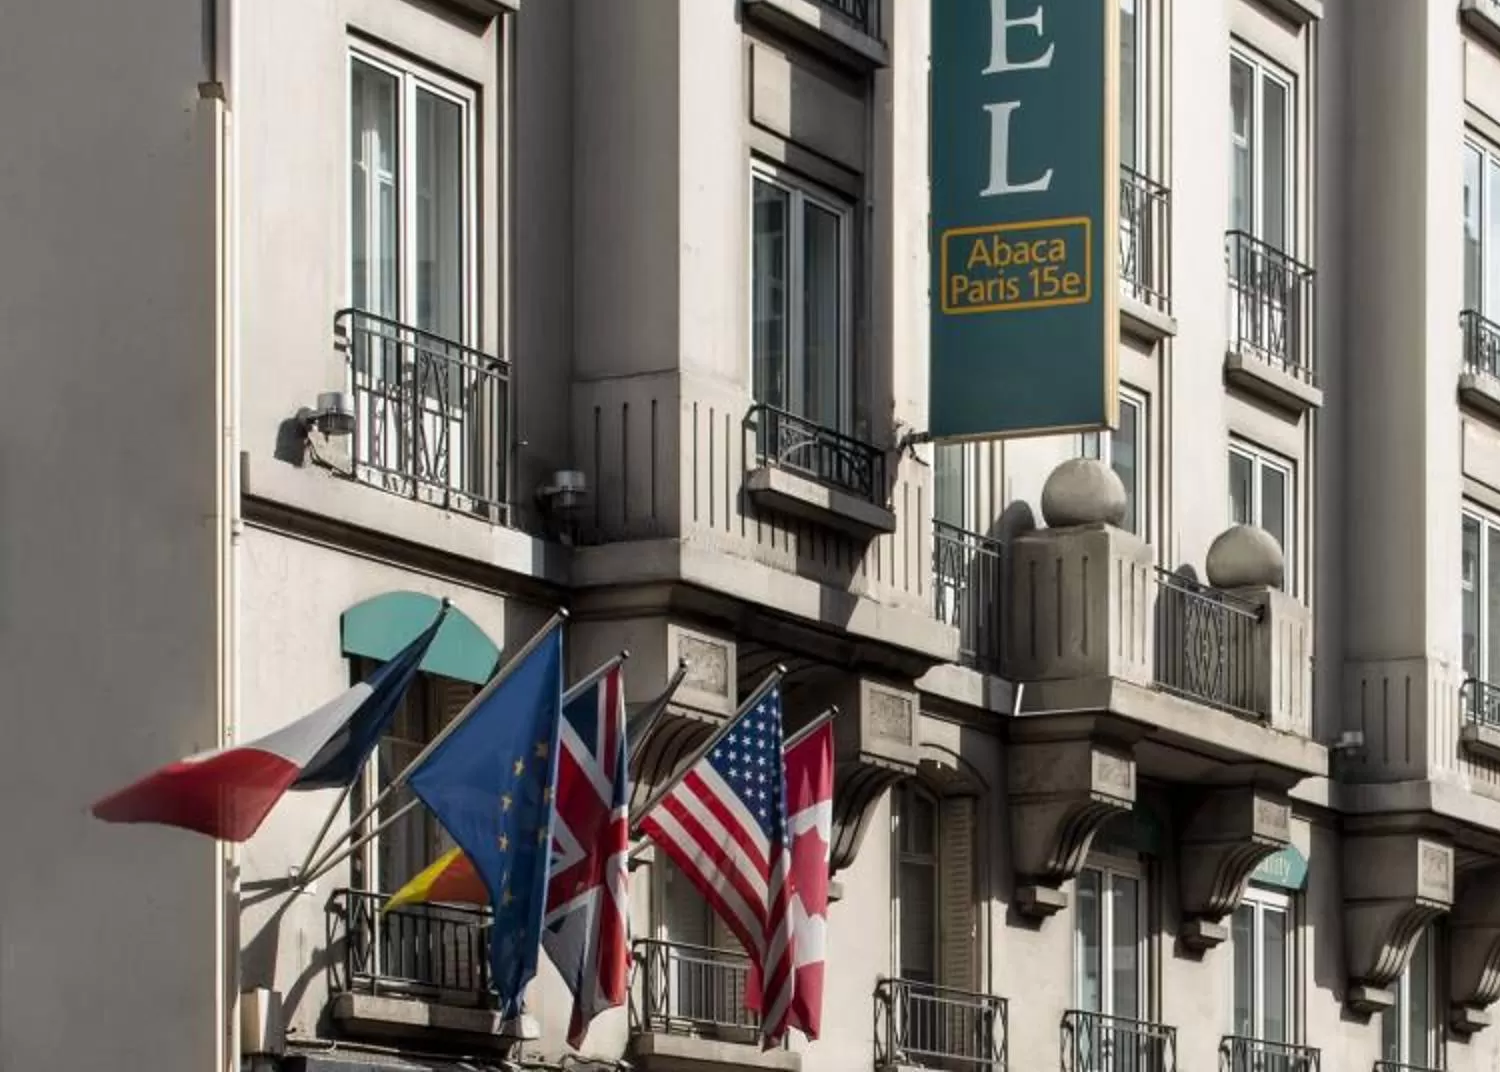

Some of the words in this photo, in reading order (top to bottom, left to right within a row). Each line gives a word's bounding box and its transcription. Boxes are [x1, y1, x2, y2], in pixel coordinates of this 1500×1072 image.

[967, 234, 1066, 269] Abaca
[951, 269, 1020, 305] Paris
[1028, 266, 1082, 298] 15e
